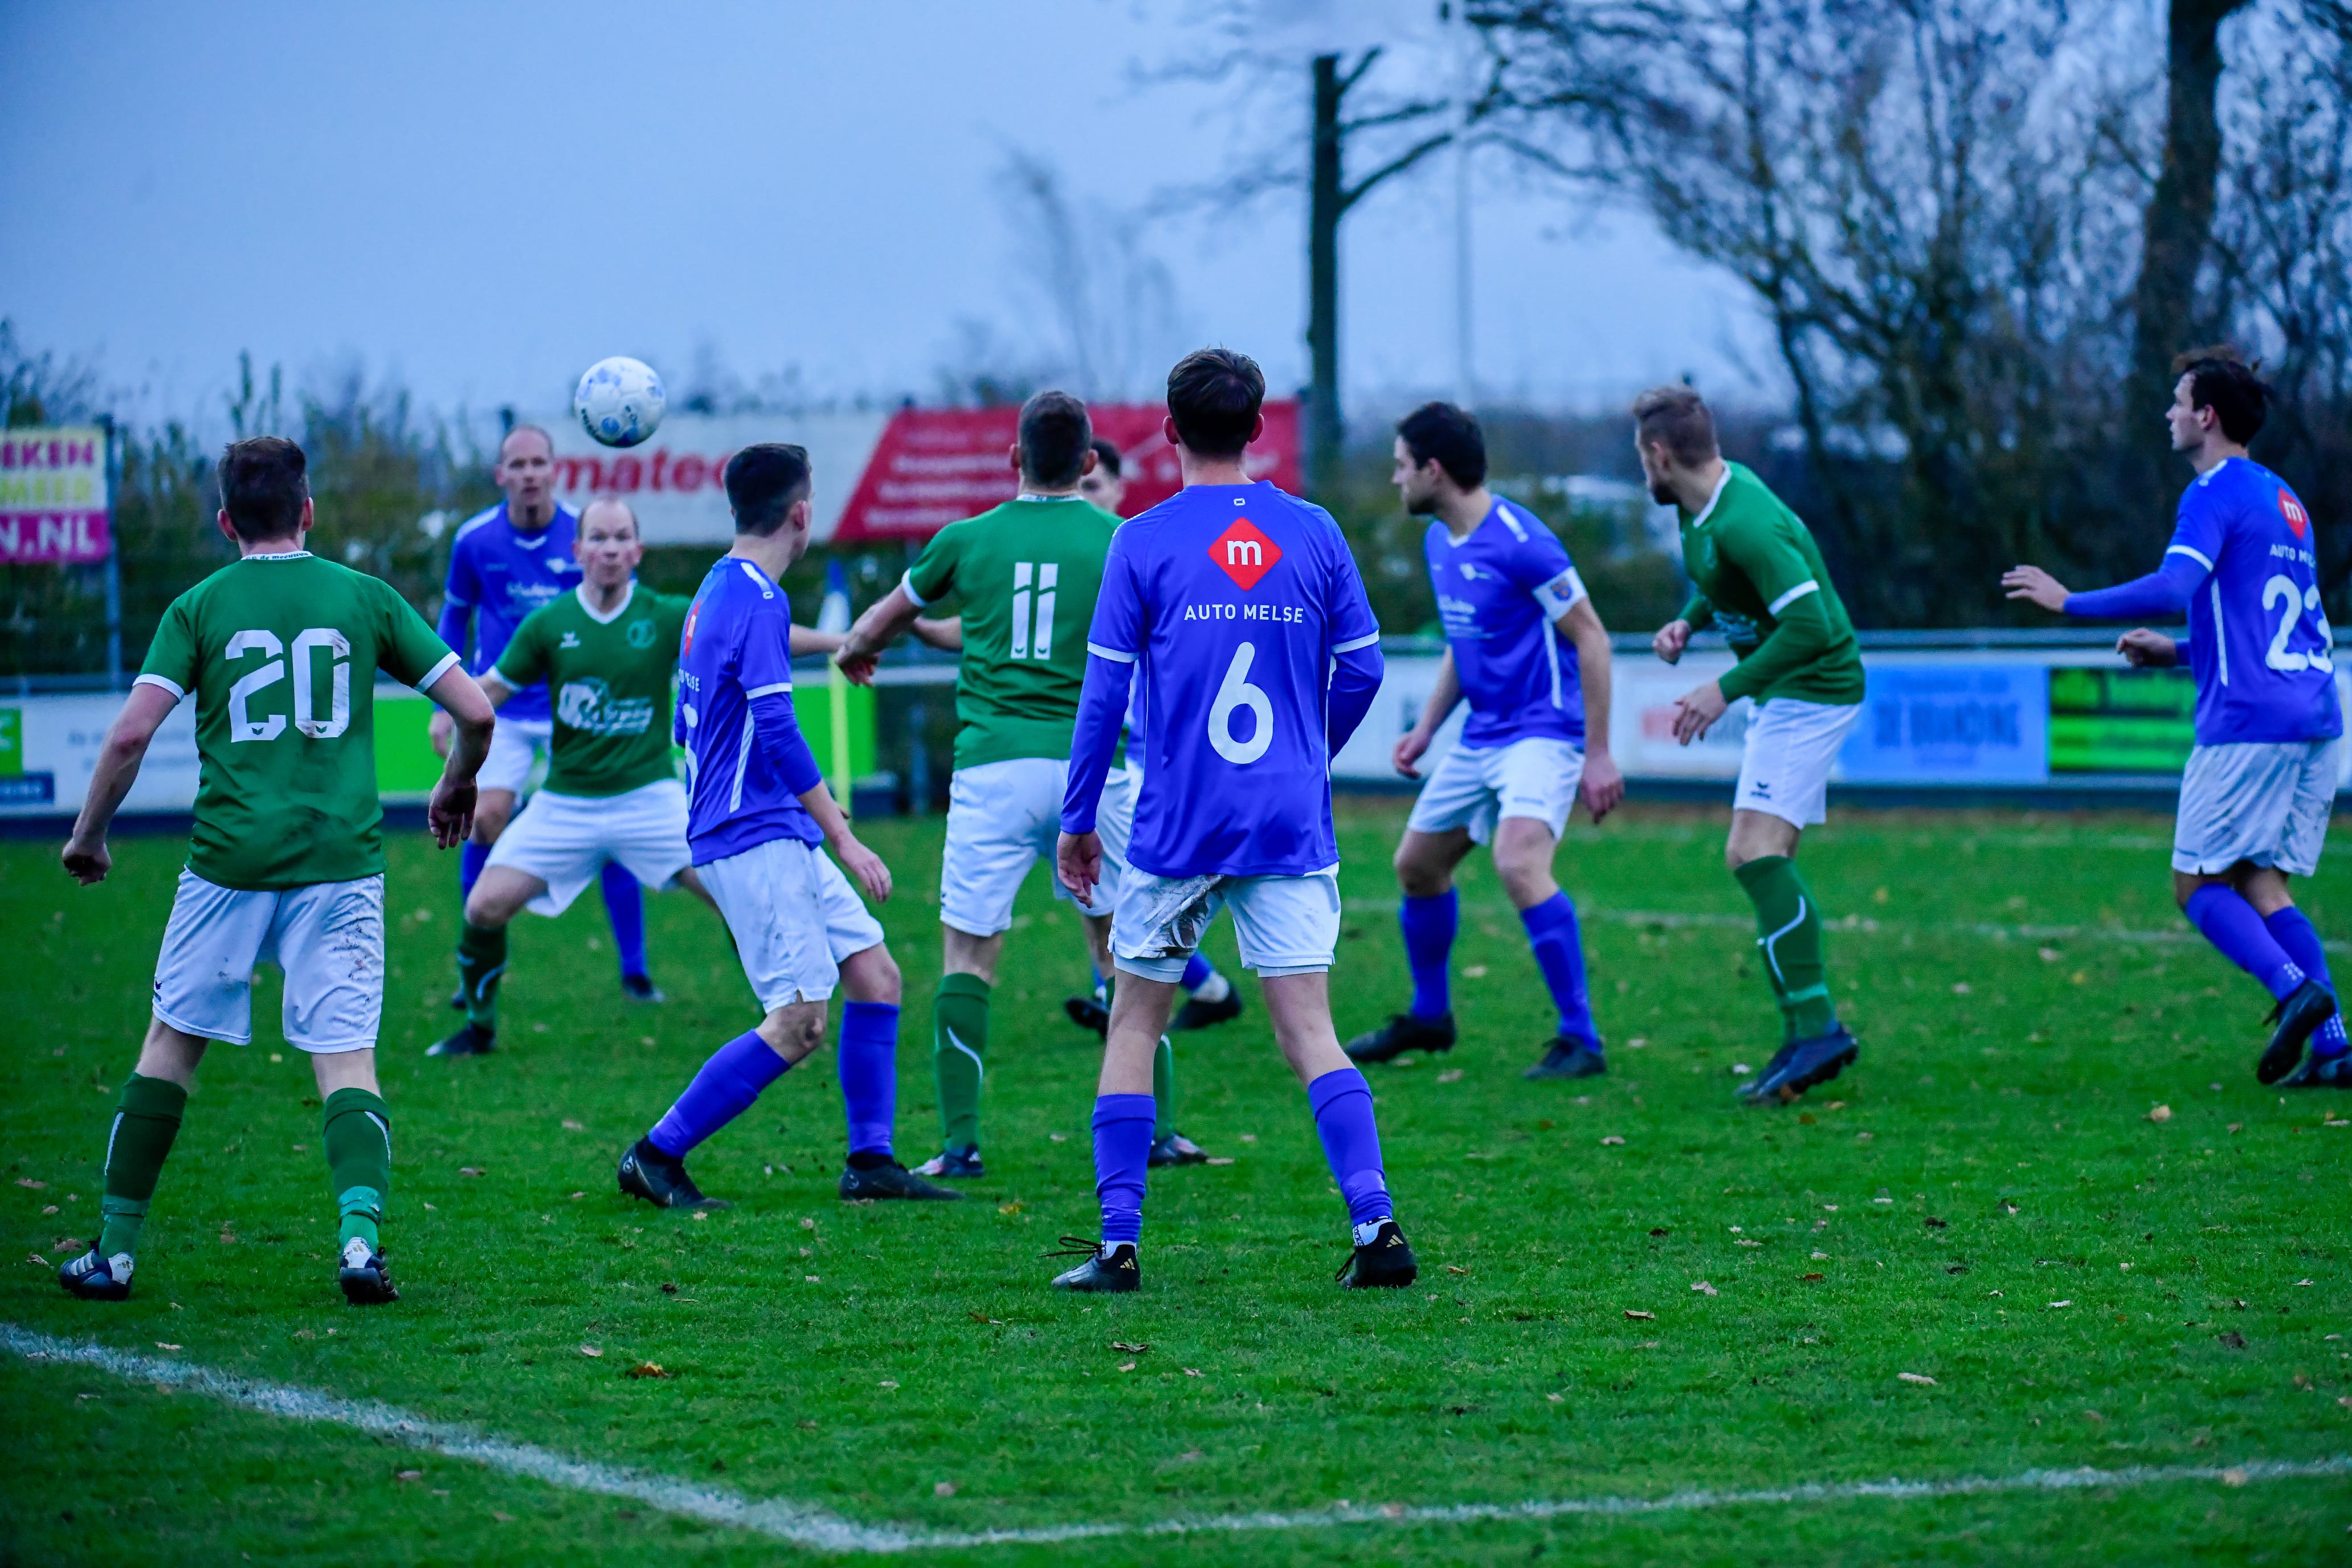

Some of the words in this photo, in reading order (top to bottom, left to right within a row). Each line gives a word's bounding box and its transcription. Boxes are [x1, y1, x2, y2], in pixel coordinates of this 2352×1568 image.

[1227, 540, 1262, 566] m
[2269, 543, 2296, 561] AUTO
[1010, 562, 1059, 660] 11
[1184, 604, 1236, 620] AUTO
[1244, 605, 1304, 623] MELSE
[225, 628, 350, 743] 20
[1208, 642, 1273, 764] 6
